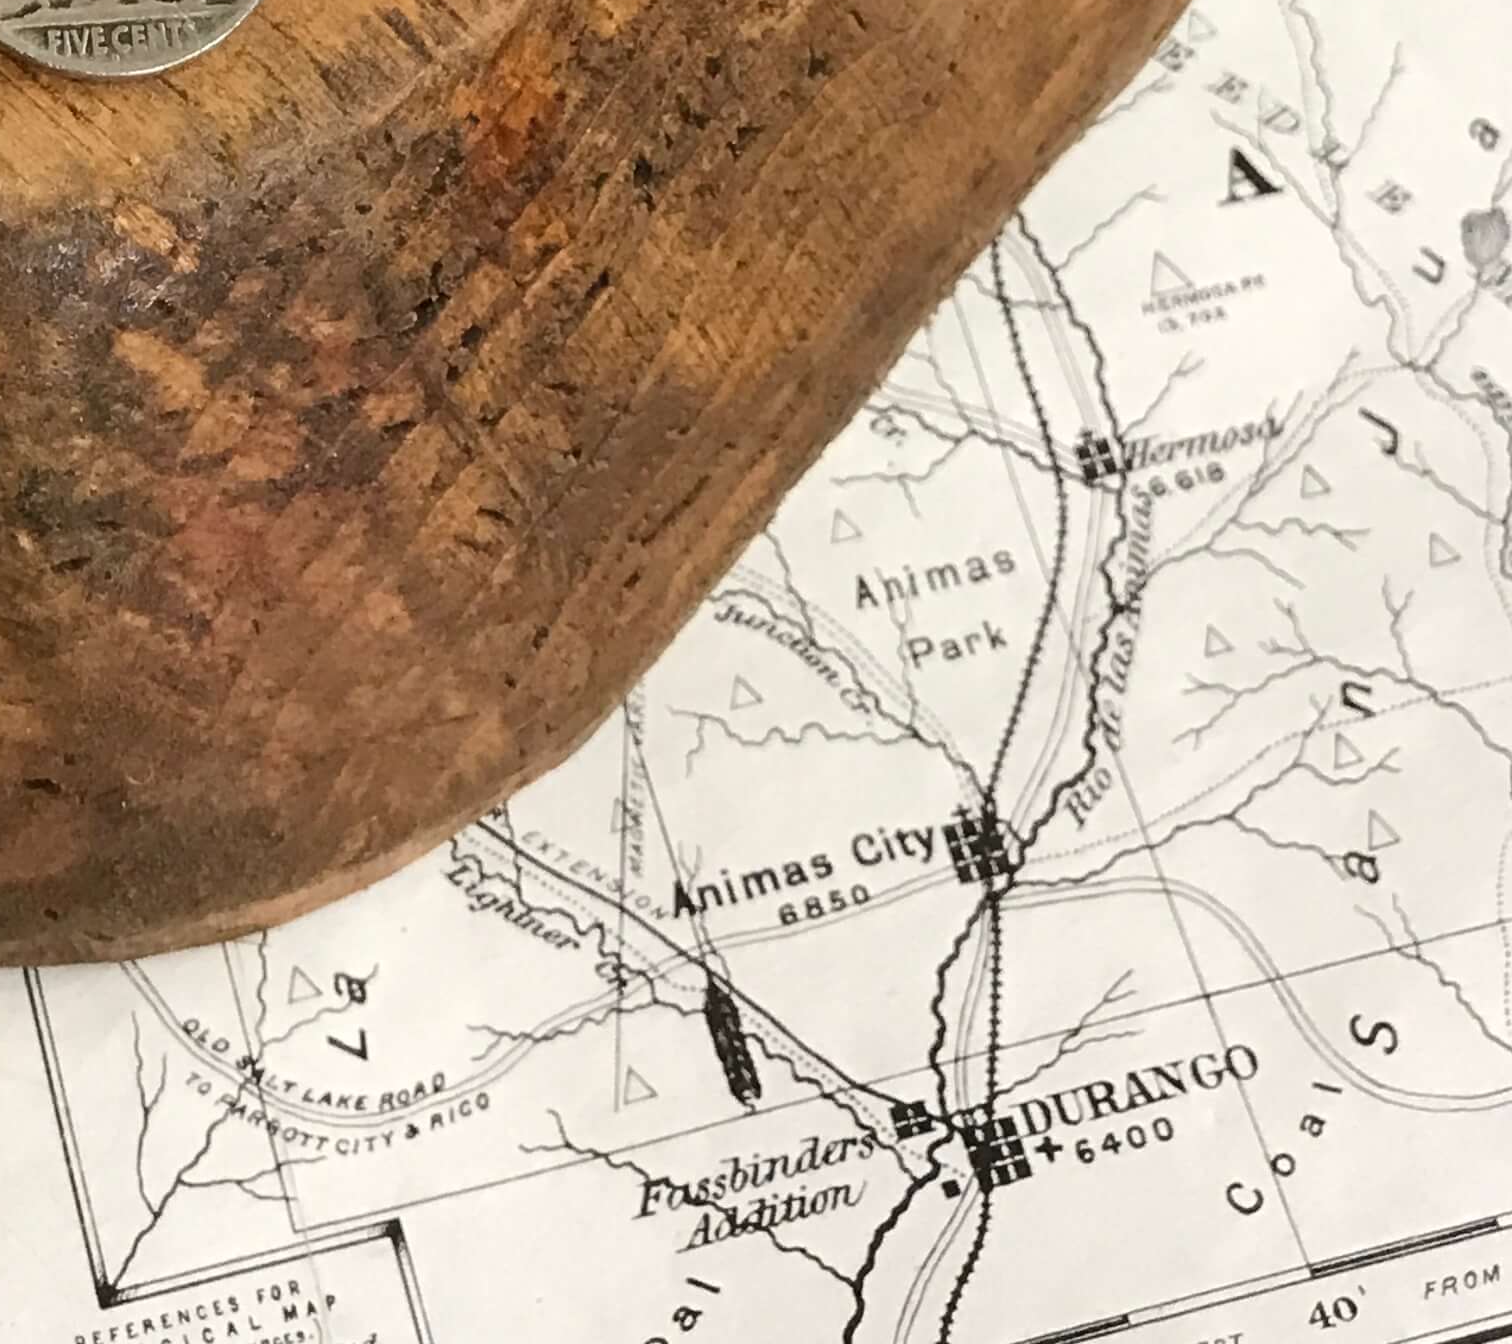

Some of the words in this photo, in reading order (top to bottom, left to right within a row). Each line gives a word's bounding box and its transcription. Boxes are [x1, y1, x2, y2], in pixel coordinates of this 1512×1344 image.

[48, 25, 110, 56] FIVE
[111, 20, 200, 54] CENTS
[1217, 146, 1283, 207] A
[855, 548, 1016, 610] Animas
[713, 603, 841, 688] Junction
[906, 618, 1008, 670] Park
[1063, 766, 1114, 831] Rio
[1101, 630, 1135, 694] las
[671, 848, 834, 920] Animas
[851, 824, 937, 876] City
[777, 883, 873, 926] 6850
[185, 1071, 212, 1097] TO
[336, 1129, 394, 1156] CITY
[428, 1092, 491, 1131] RICO
[301, 1086, 369, 1112] LAKE
[378, 1071, 447, 1113] ROAD
[1009, 1044, 1259, 1140] DURANGO
[1075, 1116, 1175, 1164] 6400
[256, 1279, 302, 1305] FOR
[282, 1294, 338, 1323] MAP
[1424, 1264, 1502, 1301] FROM
